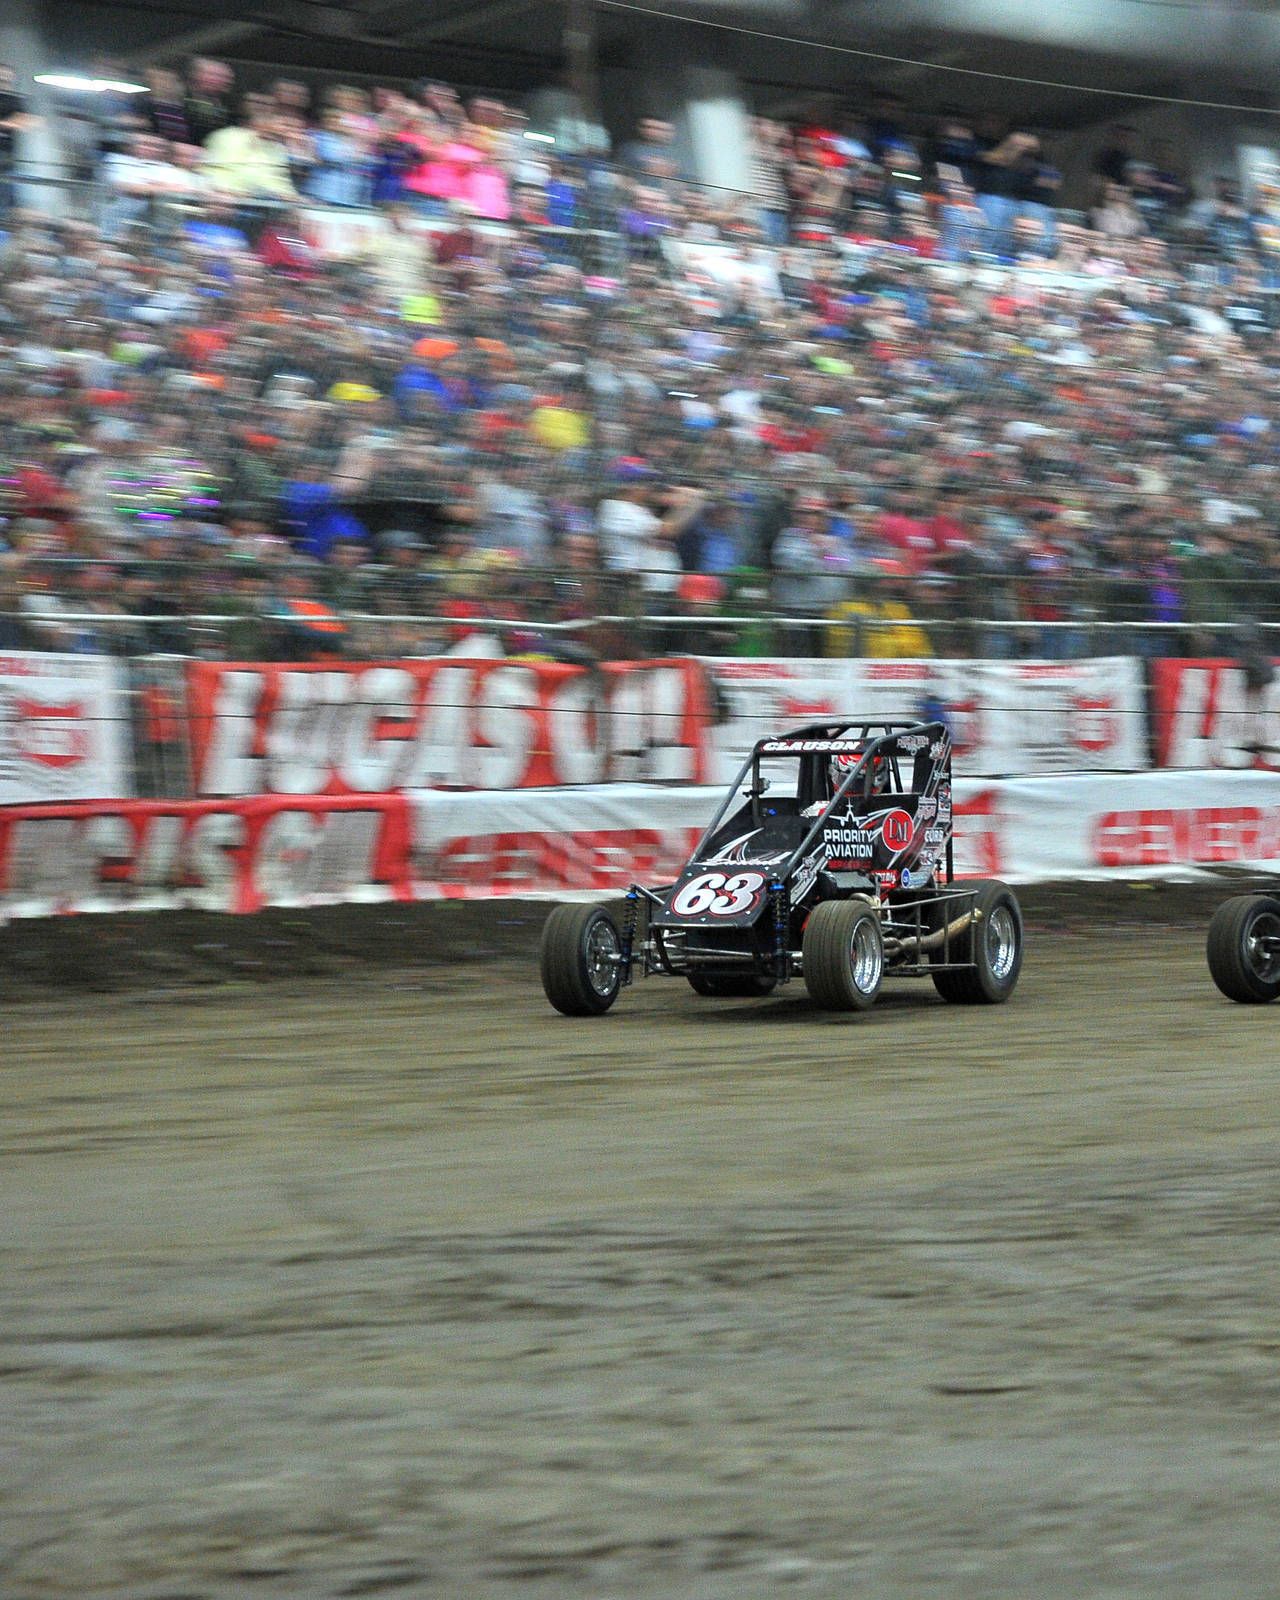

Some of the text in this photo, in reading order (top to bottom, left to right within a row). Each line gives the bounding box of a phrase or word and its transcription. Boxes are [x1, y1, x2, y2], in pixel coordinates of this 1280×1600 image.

[761, 740, 861, 752] CLAUSON
[823, 828, 873, 843] PRIORITY
[824, 844, 873, 858] AVIATION
[672, 872, 765, 916] 63
